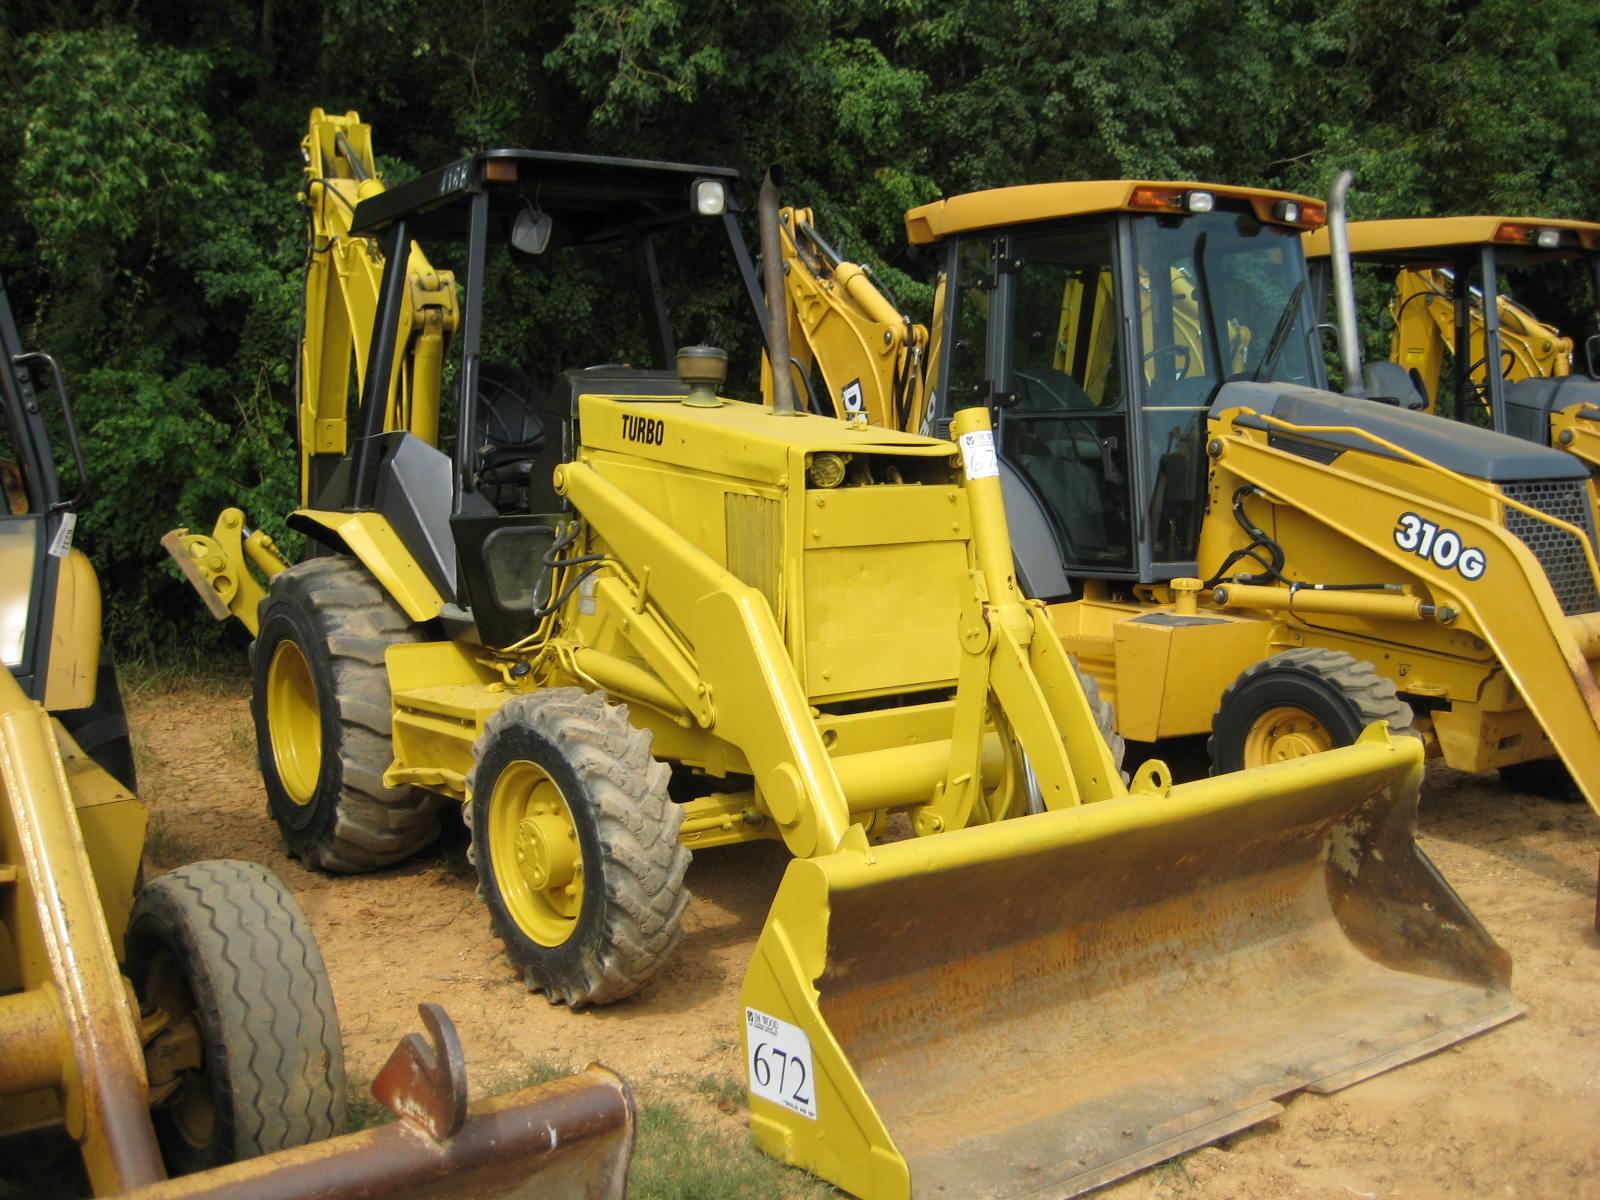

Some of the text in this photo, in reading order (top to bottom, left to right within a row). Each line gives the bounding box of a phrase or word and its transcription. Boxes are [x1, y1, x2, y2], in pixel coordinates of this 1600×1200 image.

[622, 414, 664, 446] TURBO
[1393, 511, 1487, 581] 310G
[753, 1042, 809, 1105] 672
